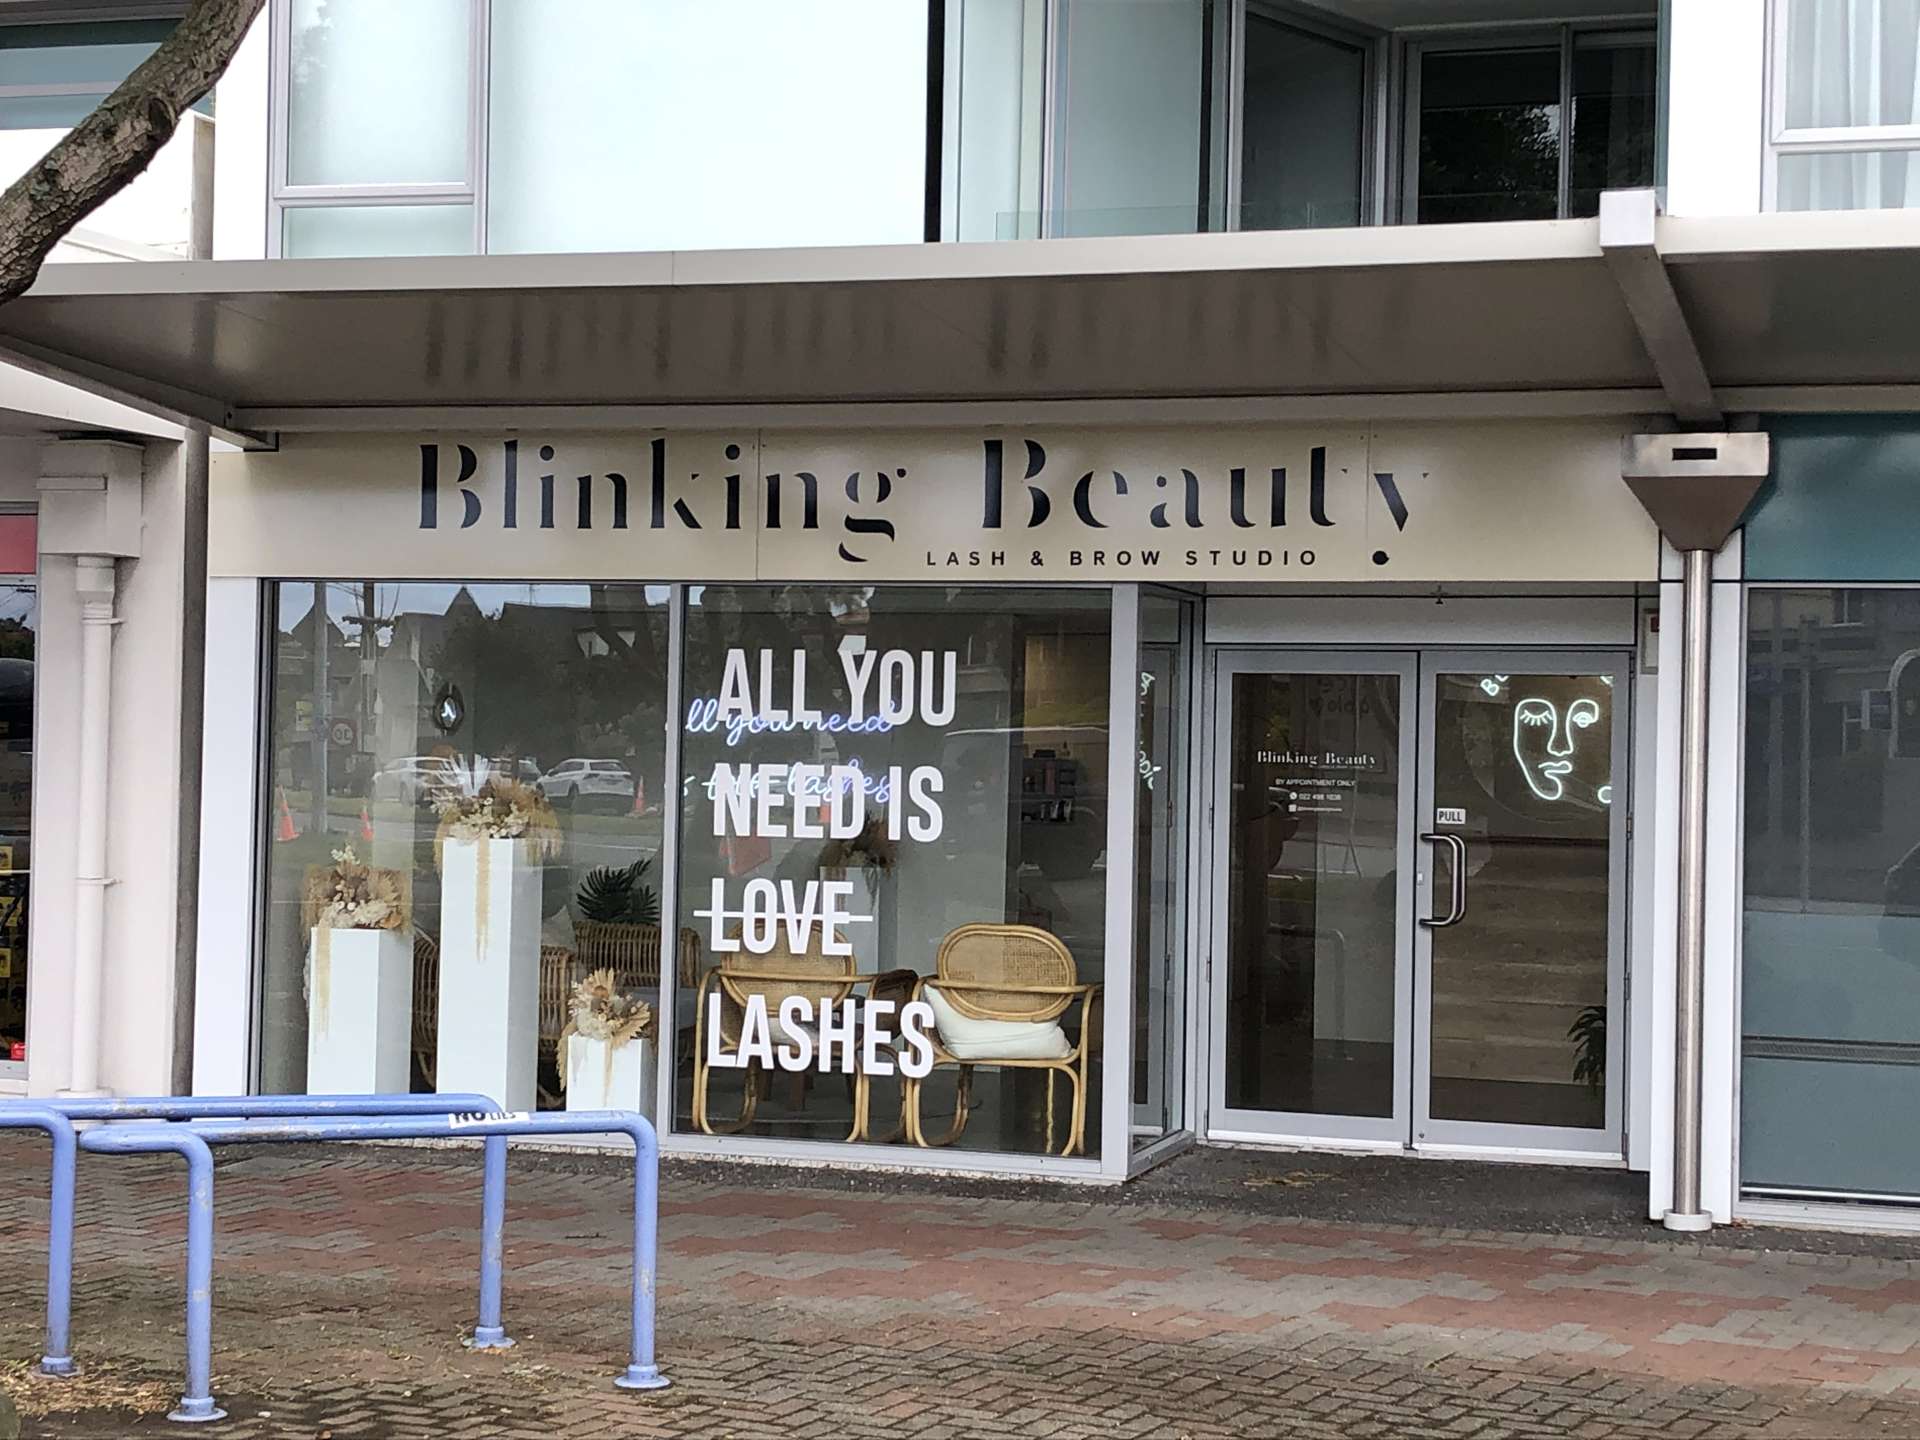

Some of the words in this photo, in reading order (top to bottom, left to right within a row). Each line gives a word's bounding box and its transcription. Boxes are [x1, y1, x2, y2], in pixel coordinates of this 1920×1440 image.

[419, 437, 907, 563] Blinking
[982, 439, 1430, 567] Beauty
[926, 551, 1005, 567] LASH
[1030, 551, 1044, 567] &
[1070, 551, 1161, 567] BROW
[1185, 550, 1316, 567] STUDIO
[716, 648, 822, 723] ALL
[837, 649, 957, 727] YOU
[1257, 750, 1318, 768] Blinking
[713, 763, 866, 841] NEED
[888, 766, 944, 843] IS
[1438, 810, 1463, 823] PULL
[710, 877, 854, 956] LOVE
[707, 992, 935, 1079] LASHES
